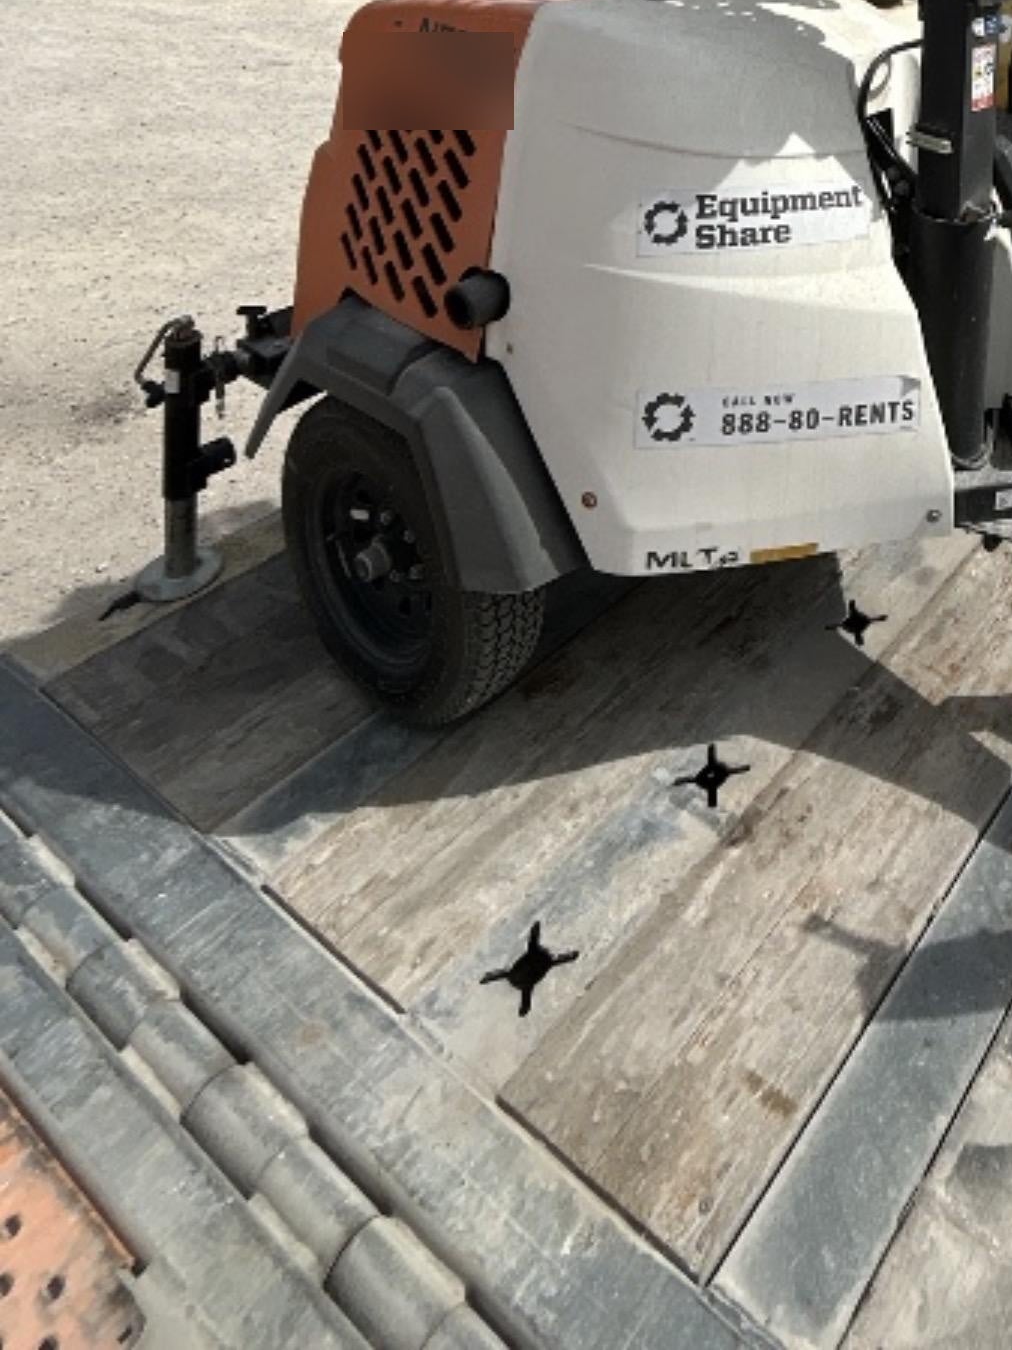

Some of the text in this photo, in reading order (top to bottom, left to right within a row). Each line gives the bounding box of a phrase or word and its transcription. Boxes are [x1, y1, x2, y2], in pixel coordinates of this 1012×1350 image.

[695, 185, 863, 222] Equipment
[695, 224, 792, 249] Share
[721, 400, 914, 436] 888-80-RENTS
